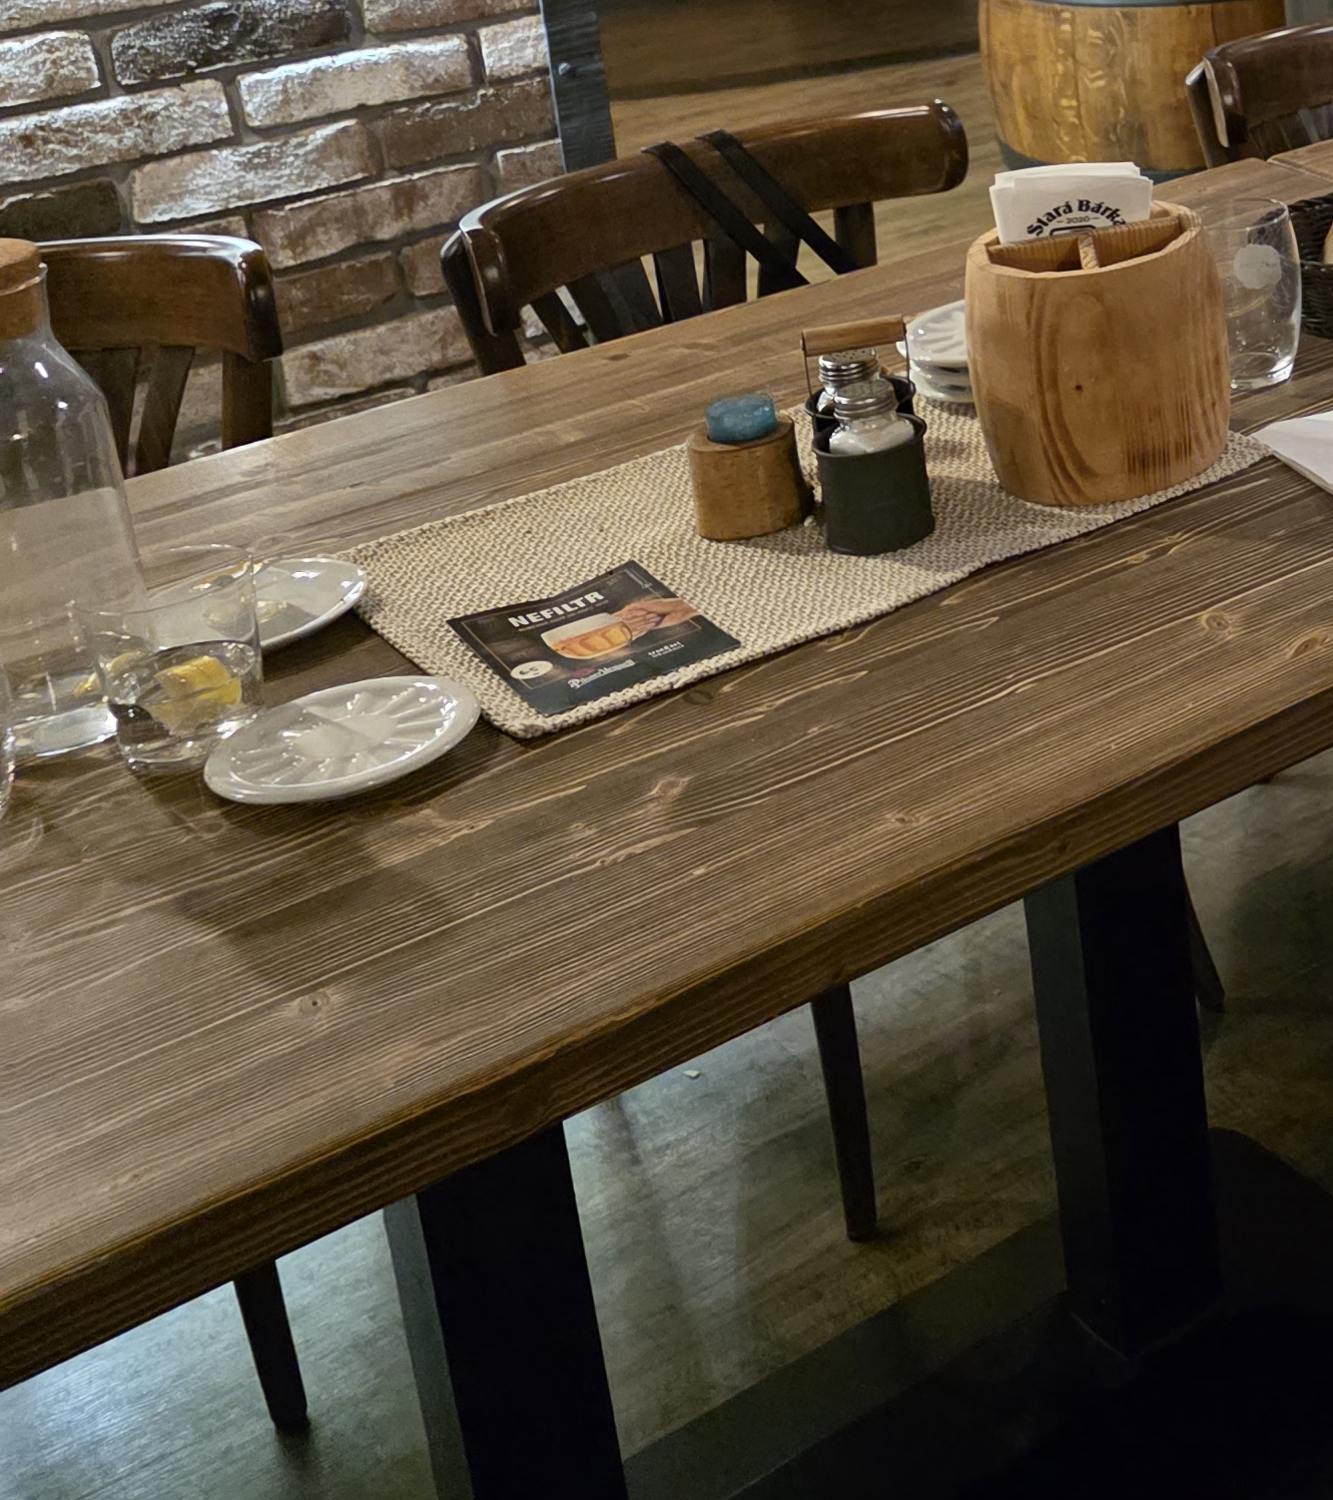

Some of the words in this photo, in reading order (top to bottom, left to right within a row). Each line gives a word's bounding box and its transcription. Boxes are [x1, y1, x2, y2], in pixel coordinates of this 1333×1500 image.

[1027, 201, 1073, 237] Stará
[1066, 216, 1090, 224] 2020
[508, 591, 605, 628] NEFILTR
